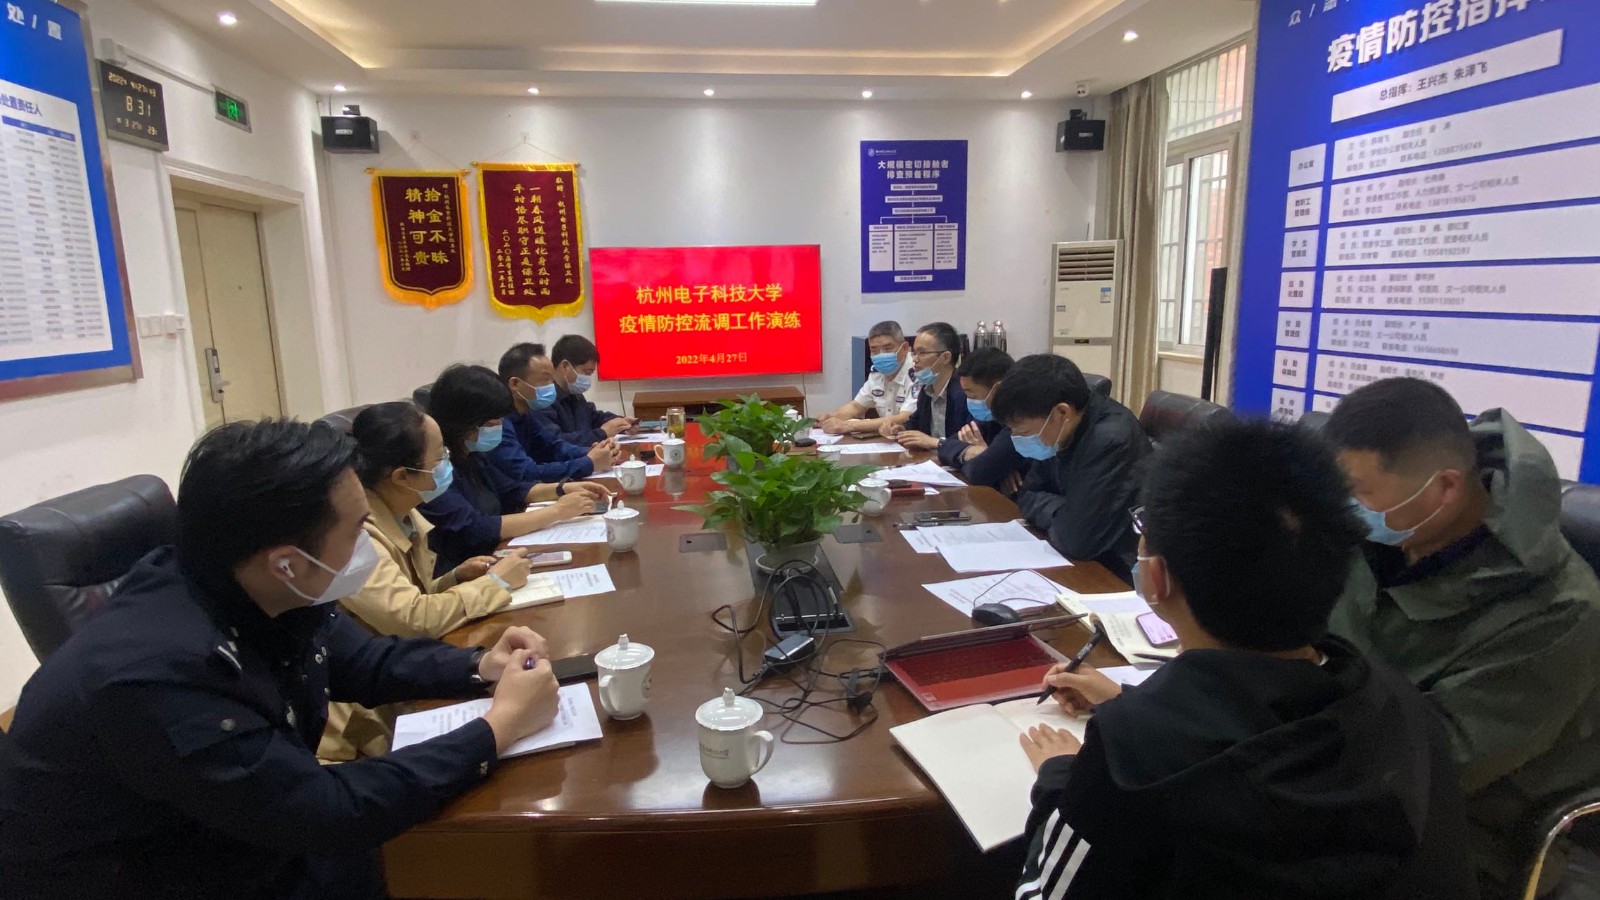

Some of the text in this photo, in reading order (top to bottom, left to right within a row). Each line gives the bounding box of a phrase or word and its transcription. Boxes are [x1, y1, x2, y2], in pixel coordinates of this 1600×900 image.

[877, 159, 949, 170] 大规模密切接触者
[405, 187, 430, 265] 精神可贵
[424, 187, 449, 265] 拾金不昧
[529, 186, 551, 296] 一朝春风送暖化身及时雨
[636, 282, 783, 305] 杭州电子科技大学
[619, 310, 802, 334] 疫情防控流调工作演练
[676, 351, 748, 365] 2022年4月27日
